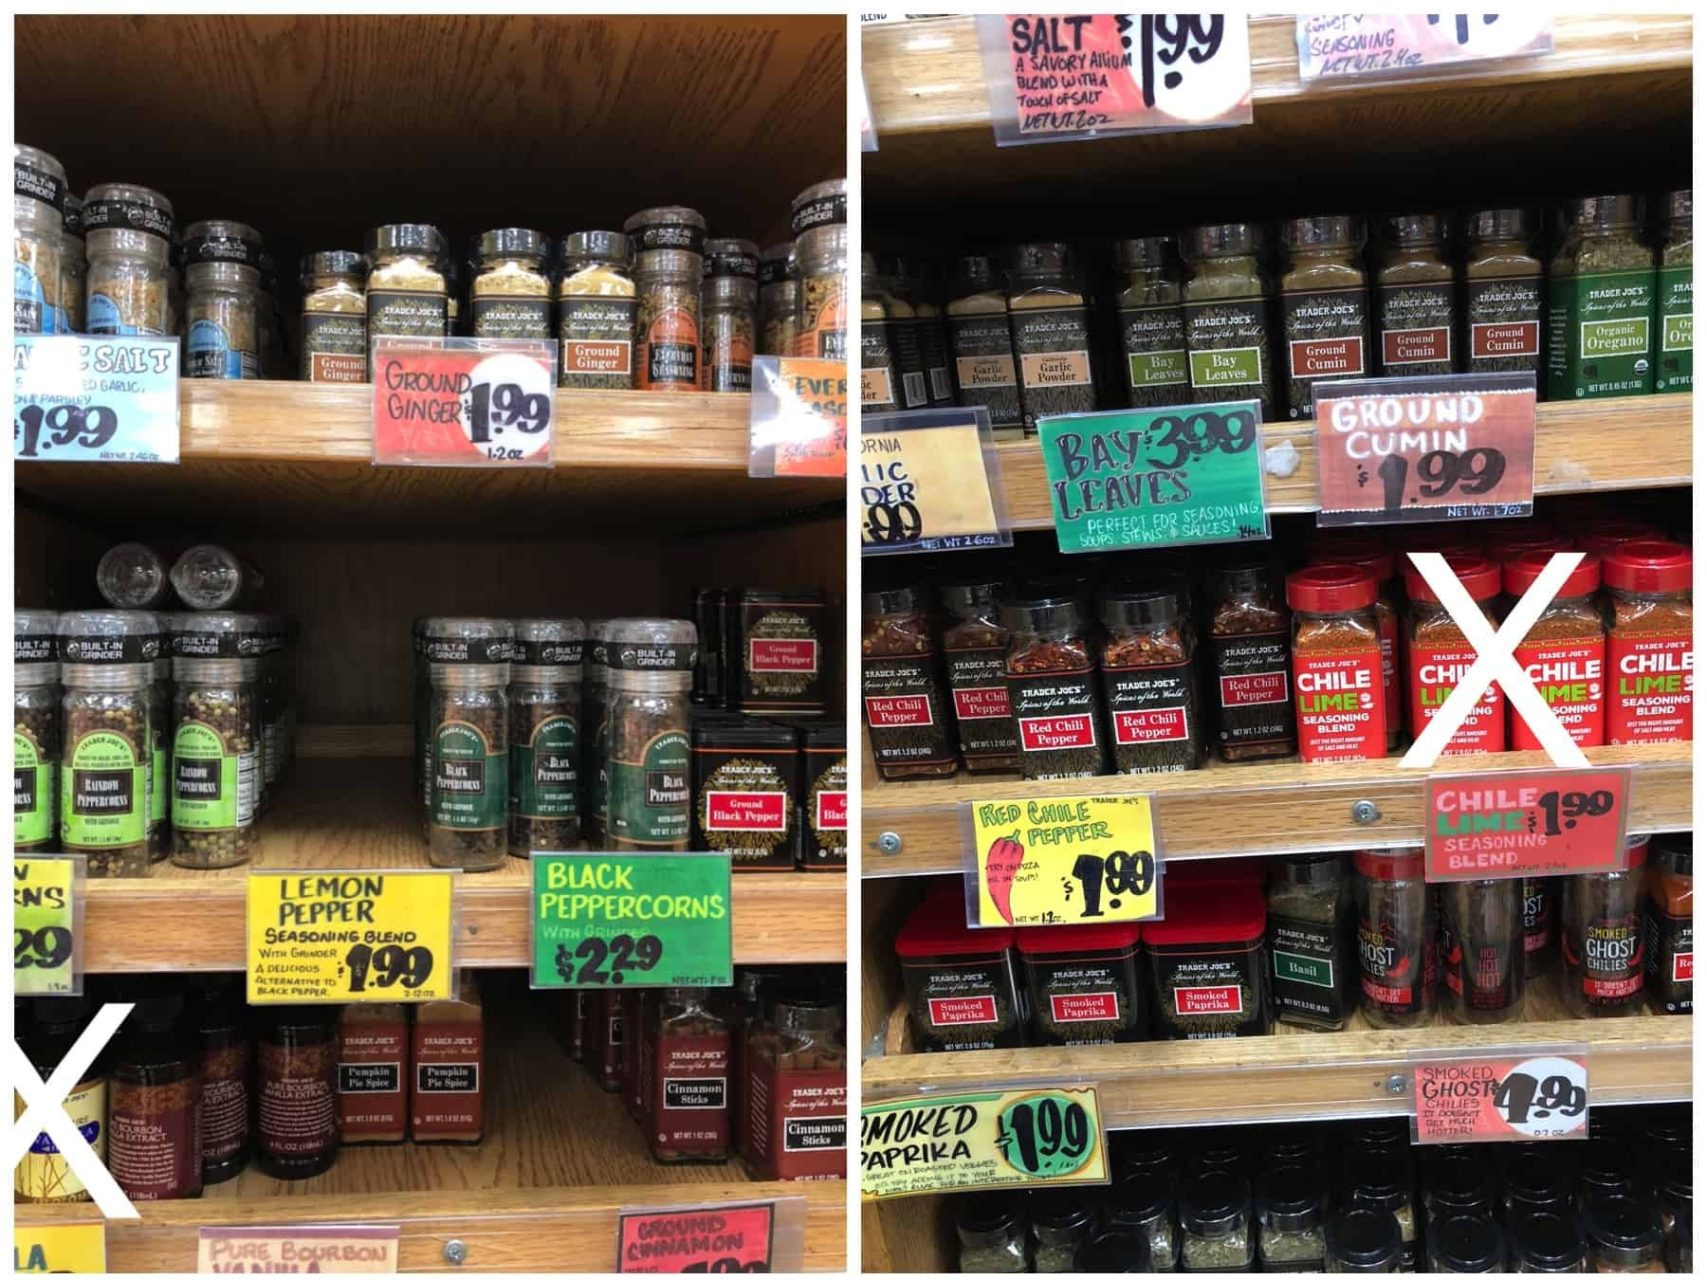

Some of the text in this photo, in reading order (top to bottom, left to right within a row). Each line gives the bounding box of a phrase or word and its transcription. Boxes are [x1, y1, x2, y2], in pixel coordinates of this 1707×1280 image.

[1012, 15, 1092, 54] SALT
[1311, 28, 1396, 56] SEASONING
[1016, 53, 1086, 72] A SAVORY
[1017, 74, 1108, 90] BLEND A
[1072, 91, 1103, 105] SALT
[16, 180, 55, 201] GRINDER
[1194, 316, 1226, 328] TRADER
[1486, 327, 1524, 339] Ground
[1596, 323, 1635, 338] Organic
[1306, 344, 1346, 357] Ground
[1486, 339, 1525, 352] Cumin
[1587, 335, 1644, 351] Oregano
[575, 345, 620, 358] Ground
[94, 347, 170, 374] SALT
[576, 357, 618, 371] Ginger
[1039, 362, 1072, 374] Garlic
[1212, 354, 1237, 368] Bay
[1306, 357, 1347, 371] Cumin
[385, 360, 472, 395] GROUND
[1037, 371, 1077, 384] Powder
[1205, 367, 1247, 381] Leaves
[387, 394, 462, 425] GINGER
[463, 382, 550, 443] $1.99
[1331, 396, 1485, 433] GROUND
[1055, 410, 1257, 481] BAY $3.99
[1345, 428, 1468, 460] CUMIN
[1357, 447, 1506, 511] $1.99
[1053, 470, 1192, 520] LEAVES
[1087, 502, 1260, 534] PERFECT FOR SEASONING
[81, 641, 123, 651] BUILT-IN
[81, 650, 123, 660] GRINDER
[1297, 669, 1371, 692] CHILE
[1299, 693, 1359, 713] LIME
[1303, 713, 1370, 724] SEASONING
[1028, 720, 1084, 734] Red Chili
[1317, 724, 1356, 734] BLEND
[1037, 734, 1078, 746] Pepper
[1436, 787, 1539, 812] CHILE
[713, 811, 780, 823] Black Pepper
[979, 800, 1092, 828] RED CHILE
[1436, 811, 1525, 836] LIME
[1027, 821, 1113, 847] PEPPER
[1444, 834, 1548, 852] SEASONING
[1449, 852, 1518, 869] BLEND
[547, 862, 633, 890] BLACK
[1061, 850, 1155, 917] $1.99
[281, 875, 384, 900] LEMON
[279, 900, 375, 926] PEPPER
[540, 893, 726, 920] PEPPERCORNS
[264, 927, 417, 945] SEASONING BLEND
[543, 925, 580, 939] WITH
[258, 948, 337, 959] WITH GRINDER
[1586, 936, 1637, 959] GHOST
[555, 934, 663, 985] $2.29
[1587, 959, 1628, 971] CHILIES
[267, 964, 320, 974] DELICIOUS
[337, 944, 433, 992] $1.99
[255, 976, 323, 987] ALTERNATIVE
[257, 987, 289, 996] BLACK
[1186, 991, 1228, 1002] Smoked
[1186, 1000, 1230, 1011] Paprika
[427, 1067, 469, 1078] Pumpkin
[1424, 1066, 1494, 1080] SMOKED
[445, 1078, 469, 1088] Spice
[1422, 1079, 1496, 1099] GHOST
[1425, 1098, 1480, 1109] CHILIES
[788, 1124, 845, 1135] Cinnamon
[994, 1098, 1089, 1173] $1.99
[802, 1135, 831, 1145] Sticks
[638, 1216, 727, 1239] GROUND
[210, 1240, 387, 1262] PURE BOURBON
[627, 1233, 744, 1261] CINNAMON
